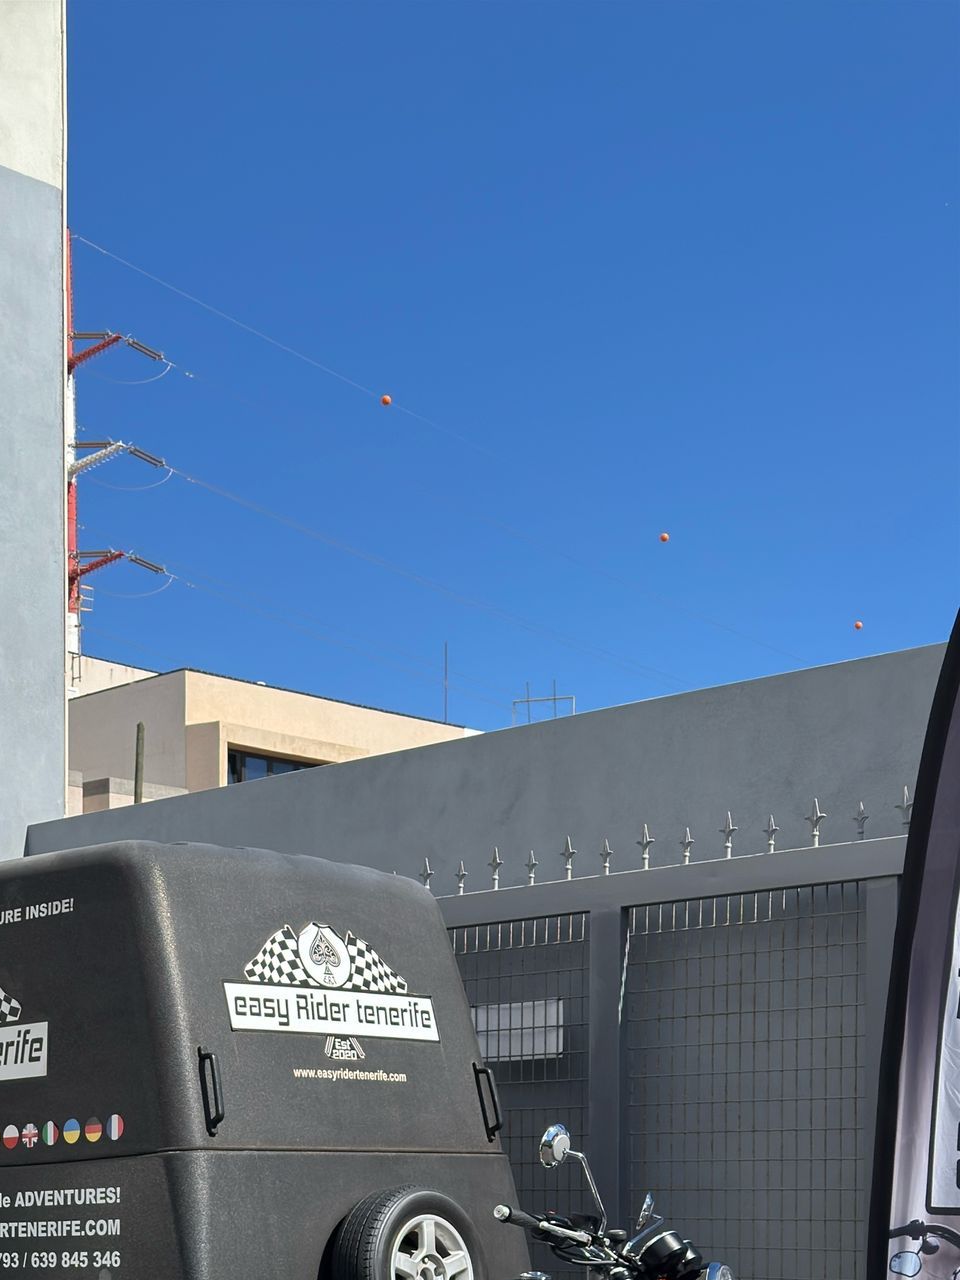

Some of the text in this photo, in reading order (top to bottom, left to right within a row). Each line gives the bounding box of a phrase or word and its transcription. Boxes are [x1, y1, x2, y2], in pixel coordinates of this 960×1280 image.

[25, 898, 75, 920] INSIDE!
[234, 993, 431, 1029] easy Rider tenerife
[335, 1039, 351, 1050] Est
[332, 1050, 358, 1060] 2020
[293, 1067, 407, 1082] www.easyridertenerife.com
[15, 1187, 121, 1208] ADVENTURES!
[22, 1253, 28, 1269] /
[30, 1252, 57, 1268] 639
[61, 1251, 88, 1268] 845
[93, 1250, 121, 1268] 346
